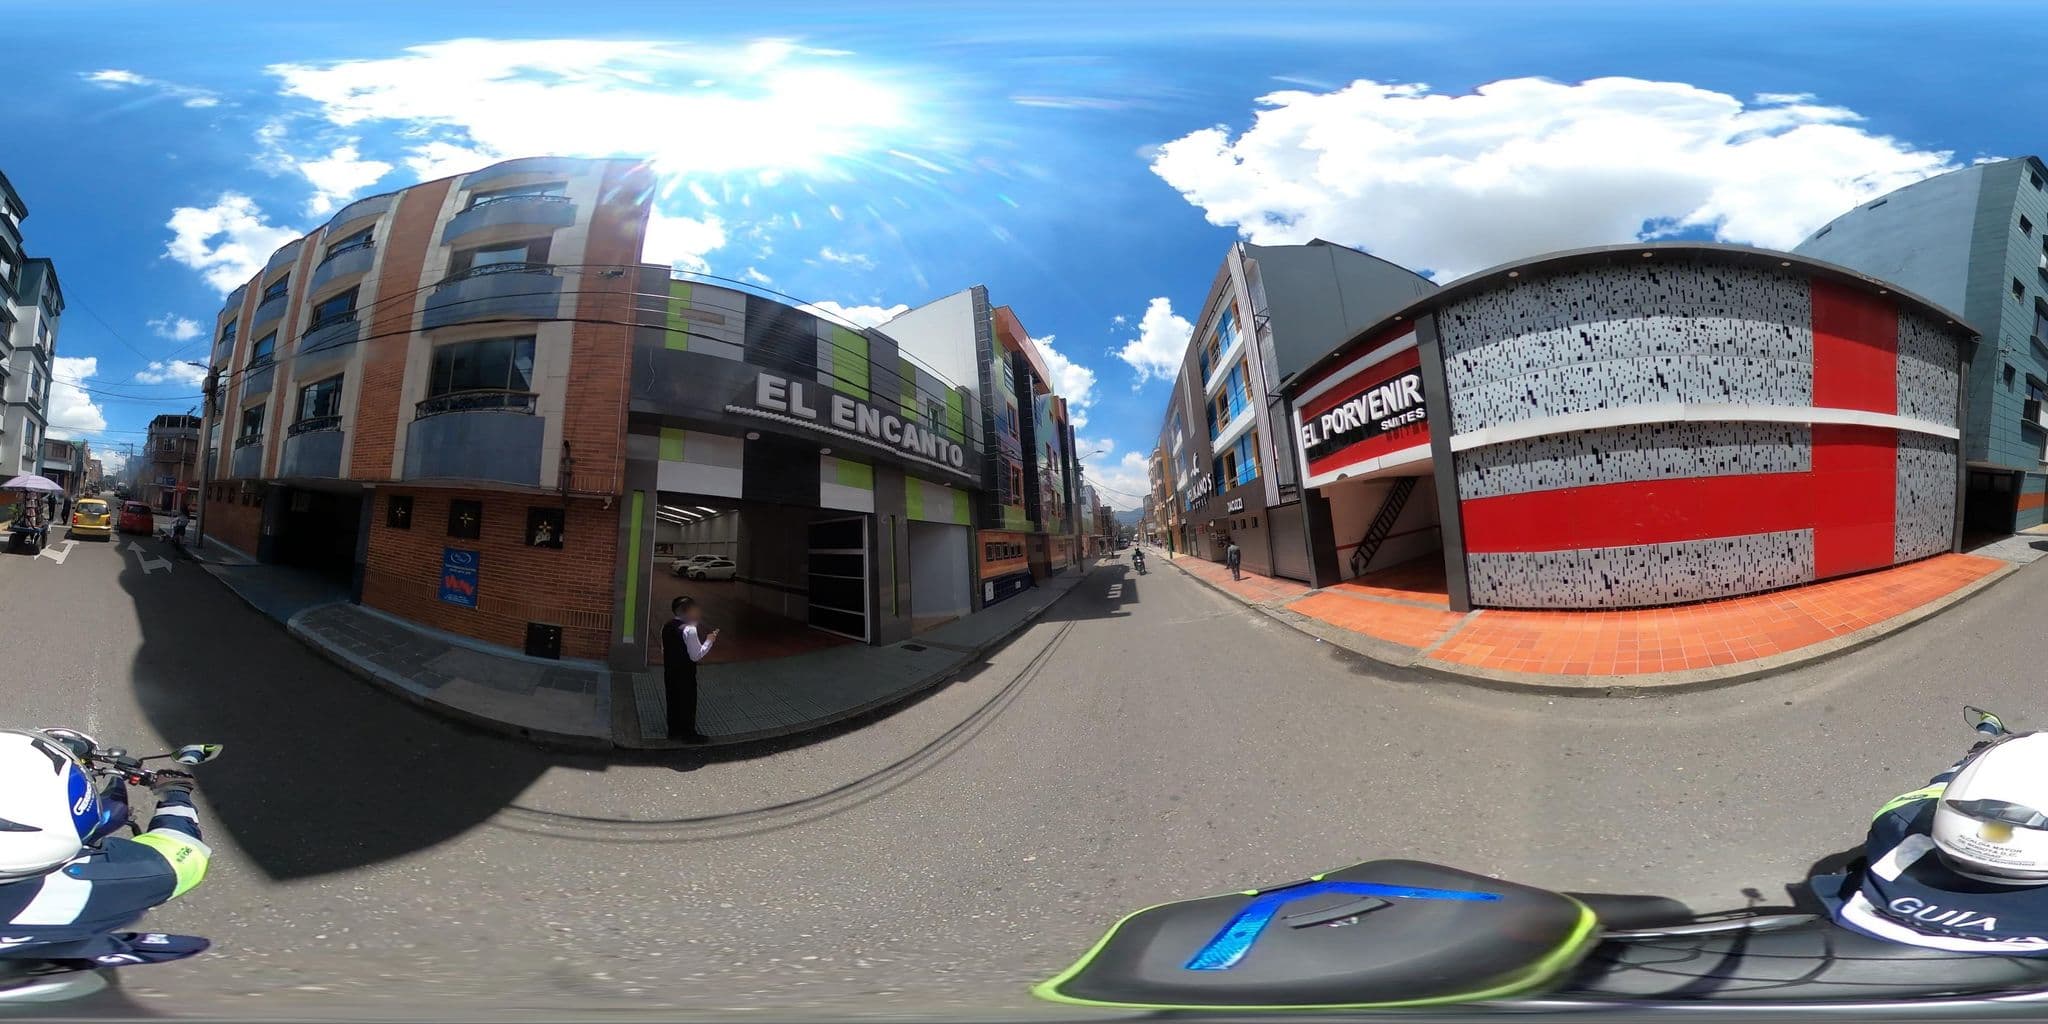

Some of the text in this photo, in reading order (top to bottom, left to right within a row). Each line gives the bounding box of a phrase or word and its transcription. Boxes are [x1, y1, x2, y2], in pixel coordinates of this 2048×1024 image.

[756, 373, 964, 468] EL ENCANTO
[1302, 374, 1424, 449] EL PORVENIR
[1381, 408, 1425, 430] SUITES
